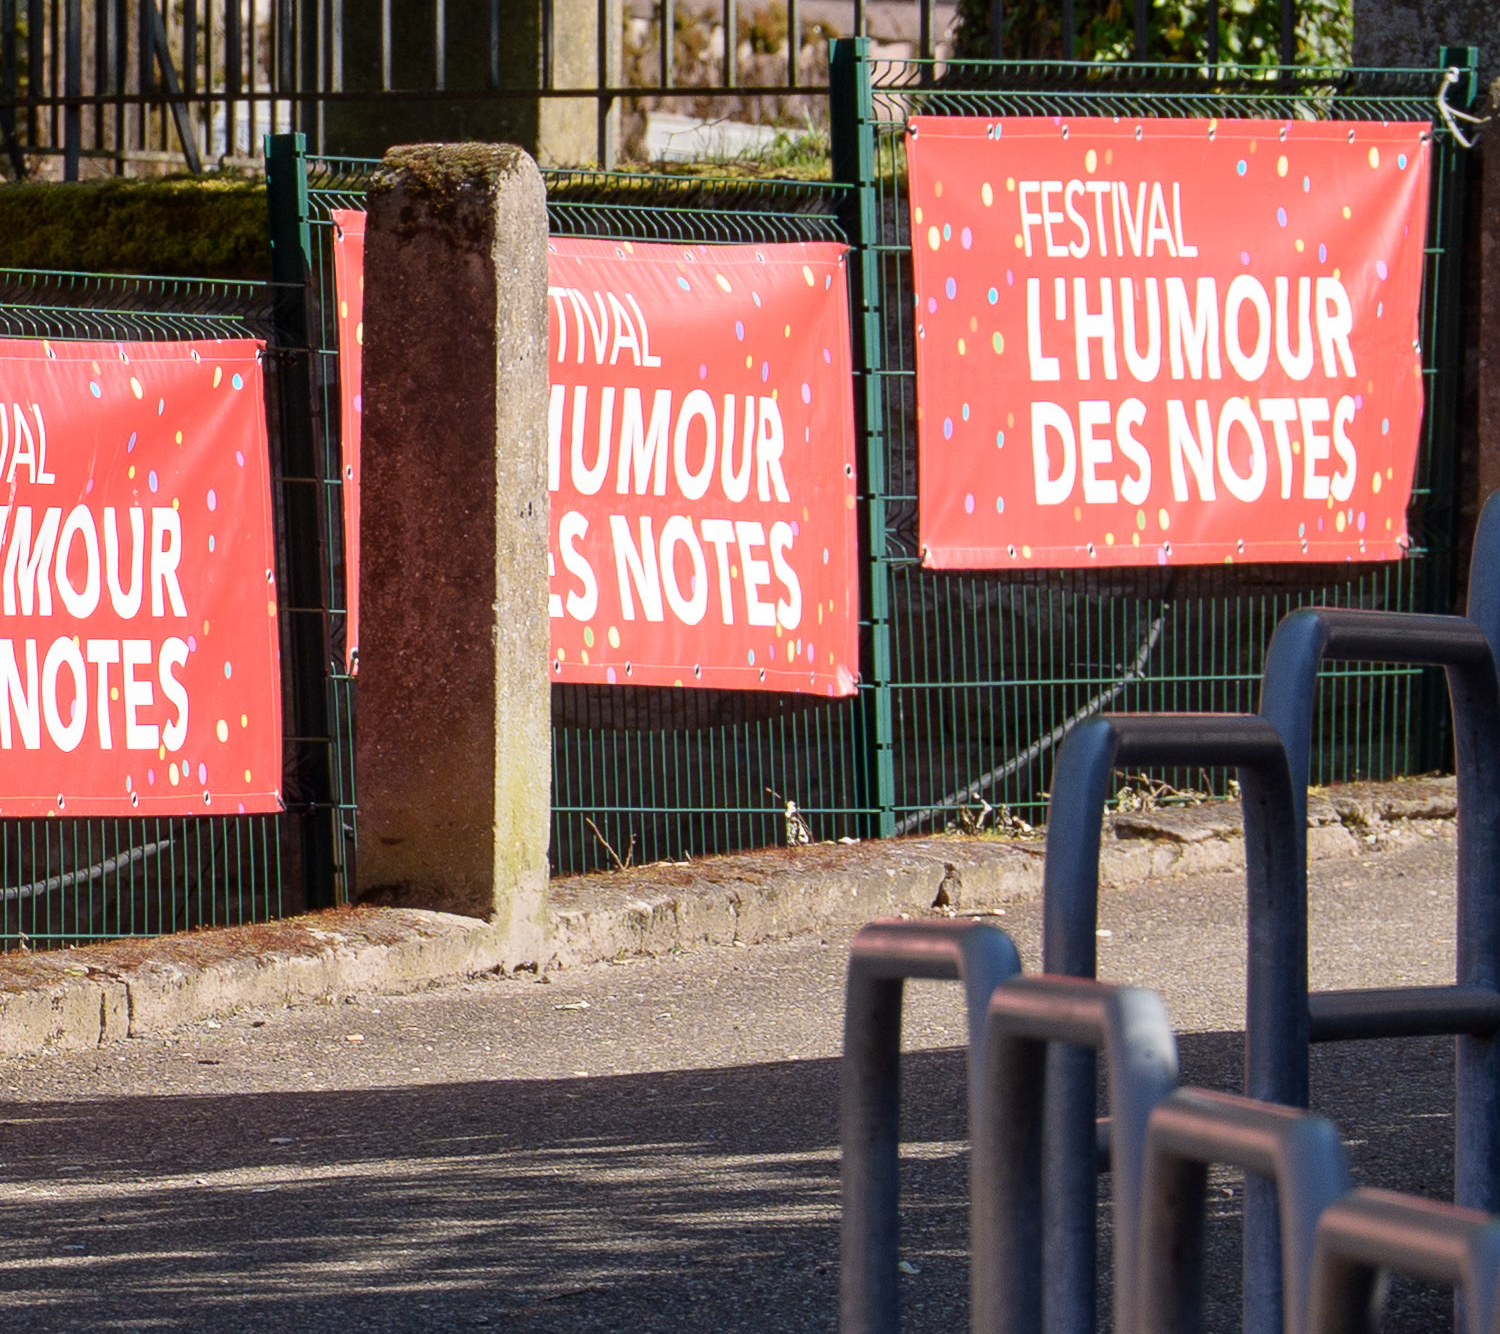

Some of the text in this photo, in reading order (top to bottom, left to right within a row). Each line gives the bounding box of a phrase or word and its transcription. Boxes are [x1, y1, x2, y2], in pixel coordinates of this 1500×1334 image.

[1018, 178, 1199, 259] FESTIVAL
[548, 285, 662, 368] TIVAL
[1026, 274, 1358, 383] L'HUMOUR
[549, 383, 791, 503] UMOUR
[1030, 394, 1358, 506] DES NOTES
[609, 513, 803, 630] NOTES
